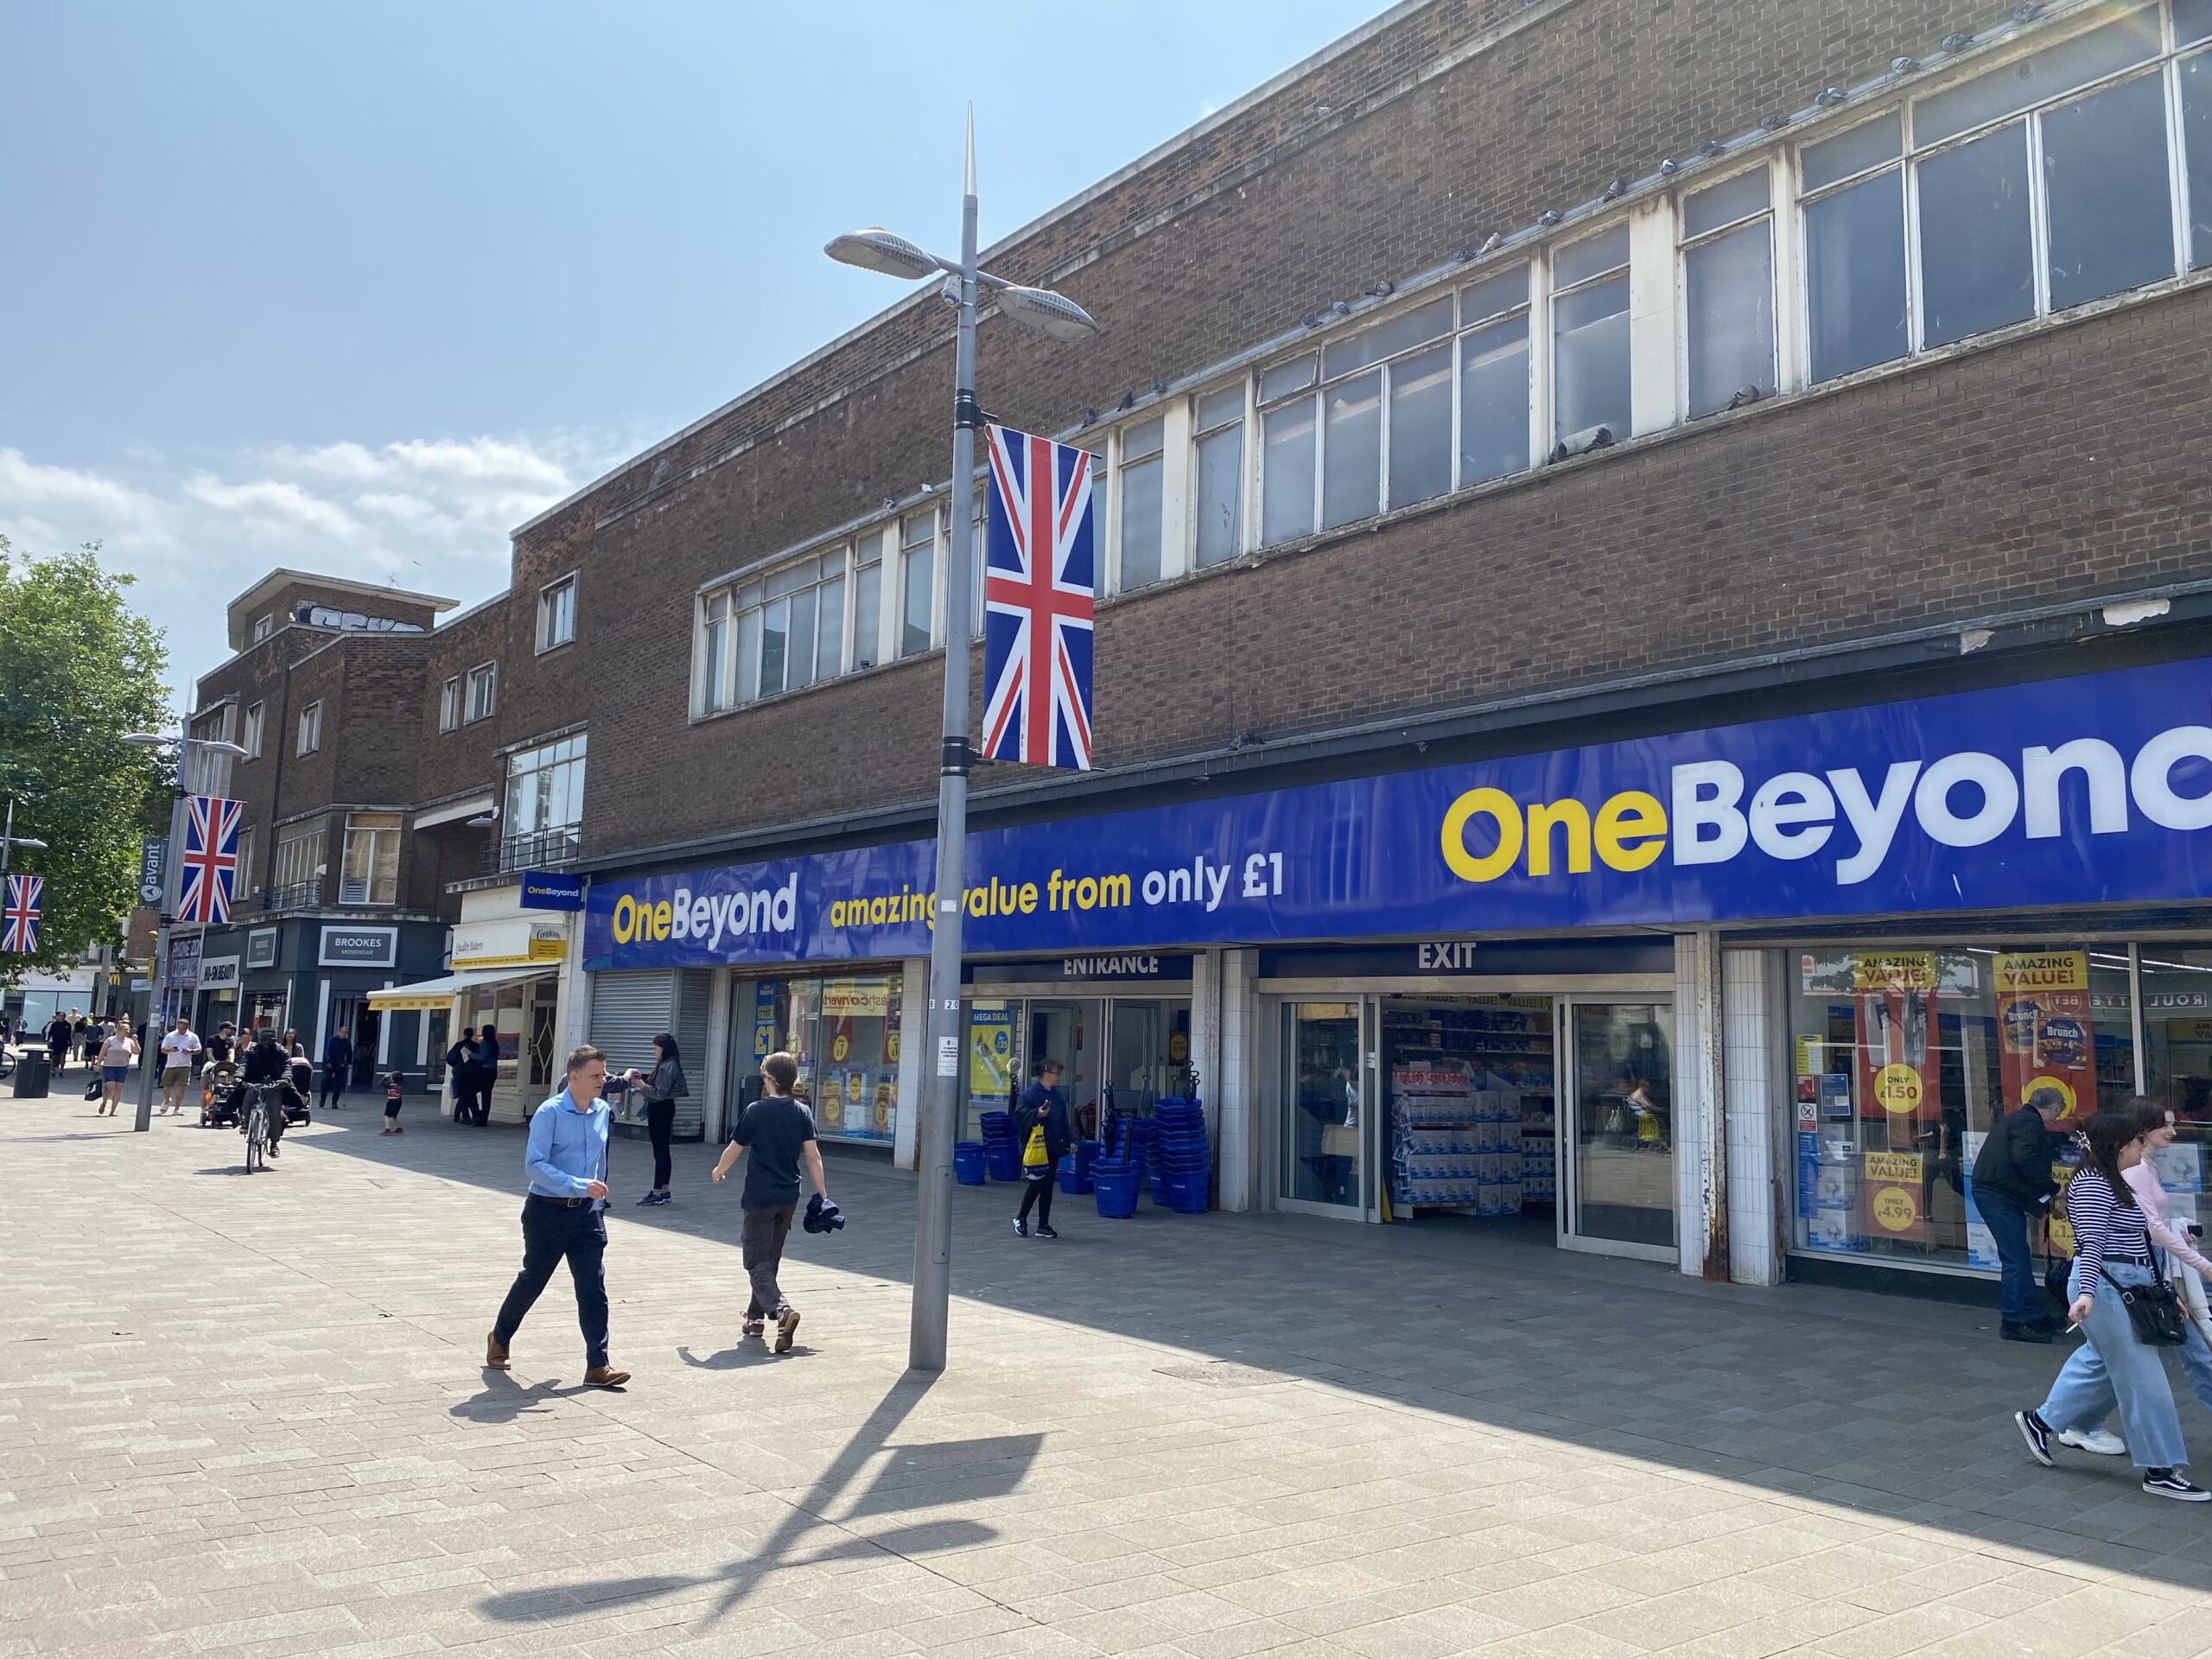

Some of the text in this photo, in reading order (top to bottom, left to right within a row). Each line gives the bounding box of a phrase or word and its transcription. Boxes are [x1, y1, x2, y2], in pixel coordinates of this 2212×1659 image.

[145, 843, 160, 885] avant
[527, 886, 579, 898] OneBeyond
[830, 885, 936, 931] amazing
[1047, 869, 1131, 912] from
[1141, 855, 1231, 912] only
[1243, 852, 1283, 897] £1
[613, 872, 798, 950] OneBeyond
[334, 938, 382, 948] BROOKES
[1418, 942, 1477, 969] EXIT
[2003, 957, 2075, 970] AMAZING
[2003, 969, 2075, 986] VALUE!
[1467, 997, 1497, 1006] VALUE!
[1508, 997, 1538, 1007] VALUE!
[973, 1013, 1009, 1021] MEGA DEAL
[2007, 1011, 2034, 1021] Brunc
[2047, 1026, 2078, 1039] Brunch
[754, 1026, 775, 1054] £1
[1880, 1085, 1917, 1100] £1.50
[1870, 1156, 1917, 1167] AMAZING
[1870, 1166, 1917, 1179] VALUE!
[1878, 1205, 1912, 1220] £4.99
